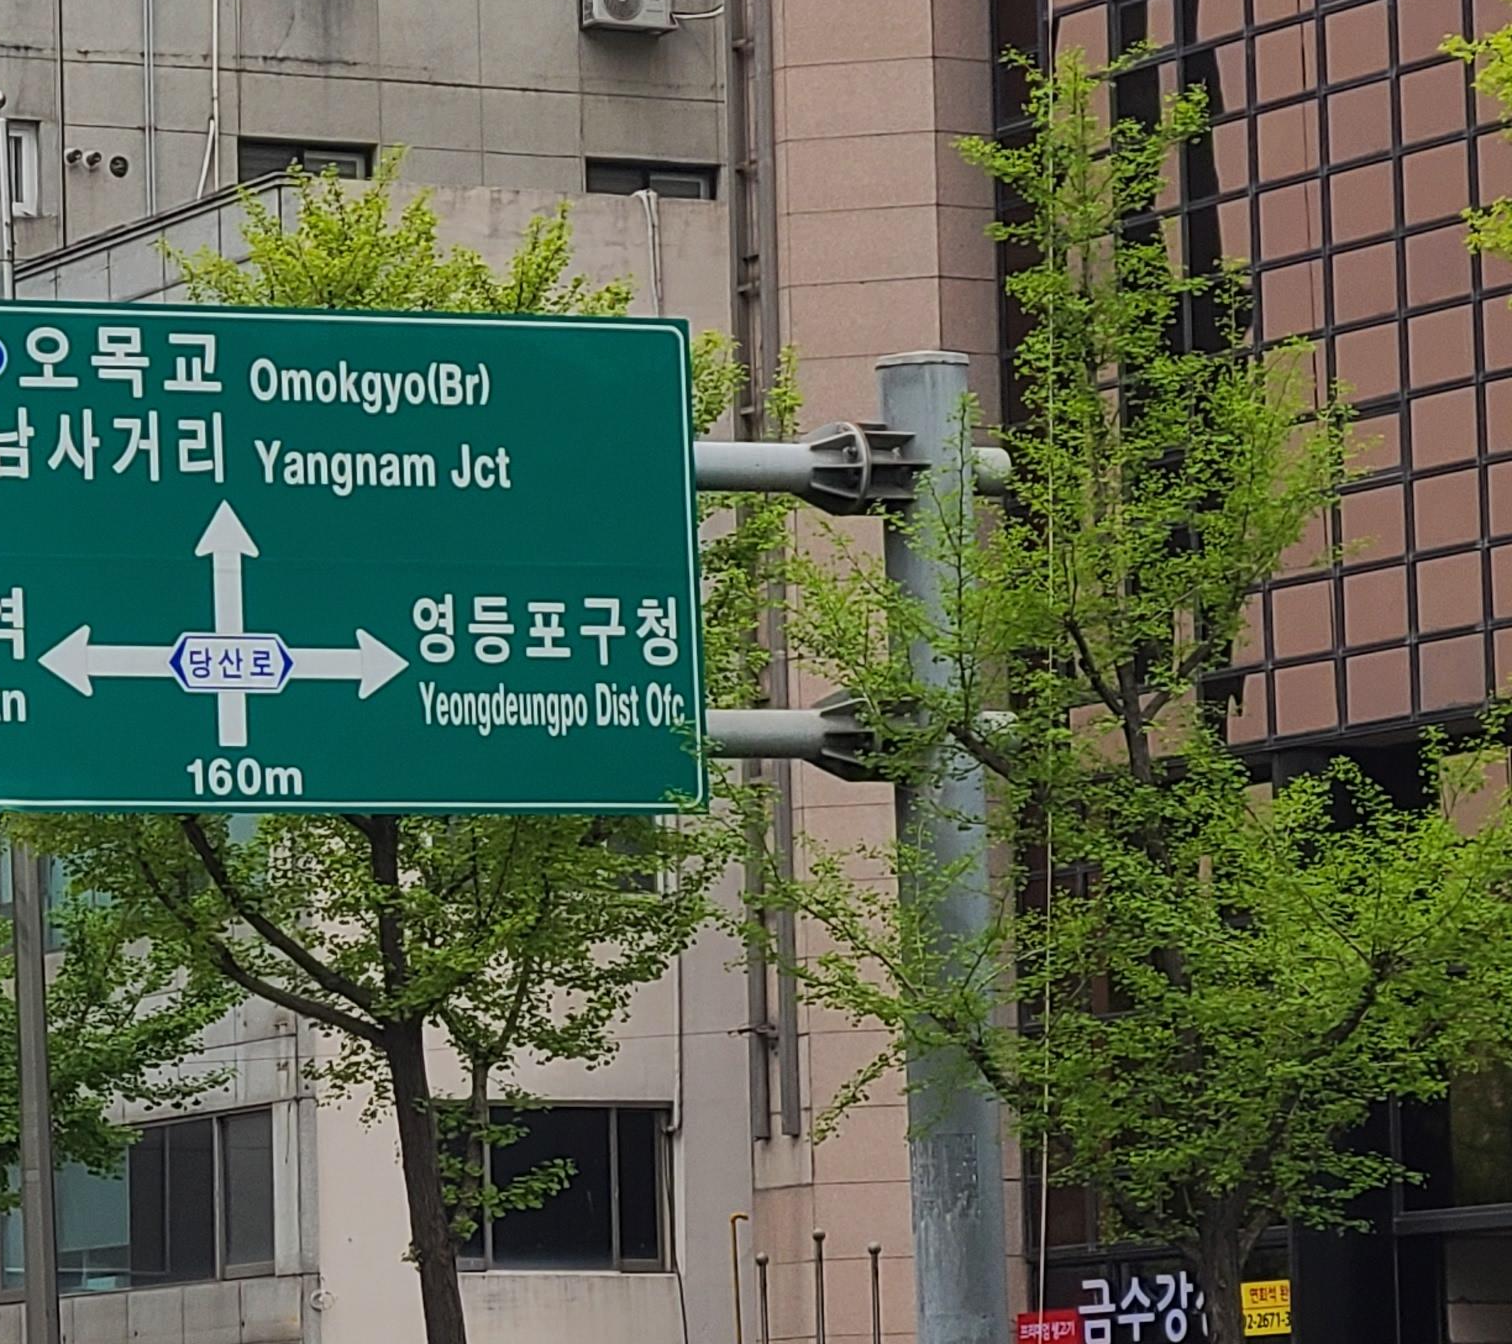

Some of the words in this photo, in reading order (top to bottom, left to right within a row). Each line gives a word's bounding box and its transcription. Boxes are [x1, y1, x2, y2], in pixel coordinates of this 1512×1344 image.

[18, 326, 223, 399] 오목교
[249, 357, 491, 414] Omokgyo(Br)
[253, 439, 437, 497] Yangnam
[450, 443, 512, 489] Jct
[412, 593, 680, 667] 영등포구청
[187, 646, 277, 680] 당산로
[418, 680, 589, 737] Yeongdeungpo
[594, 682, 640, 727] Dist
[645, 681, 686, 728] Ofc
[185, 757, 304, 796] 160m
[1244, 1311, 1291, 1330] 2-2671-3
